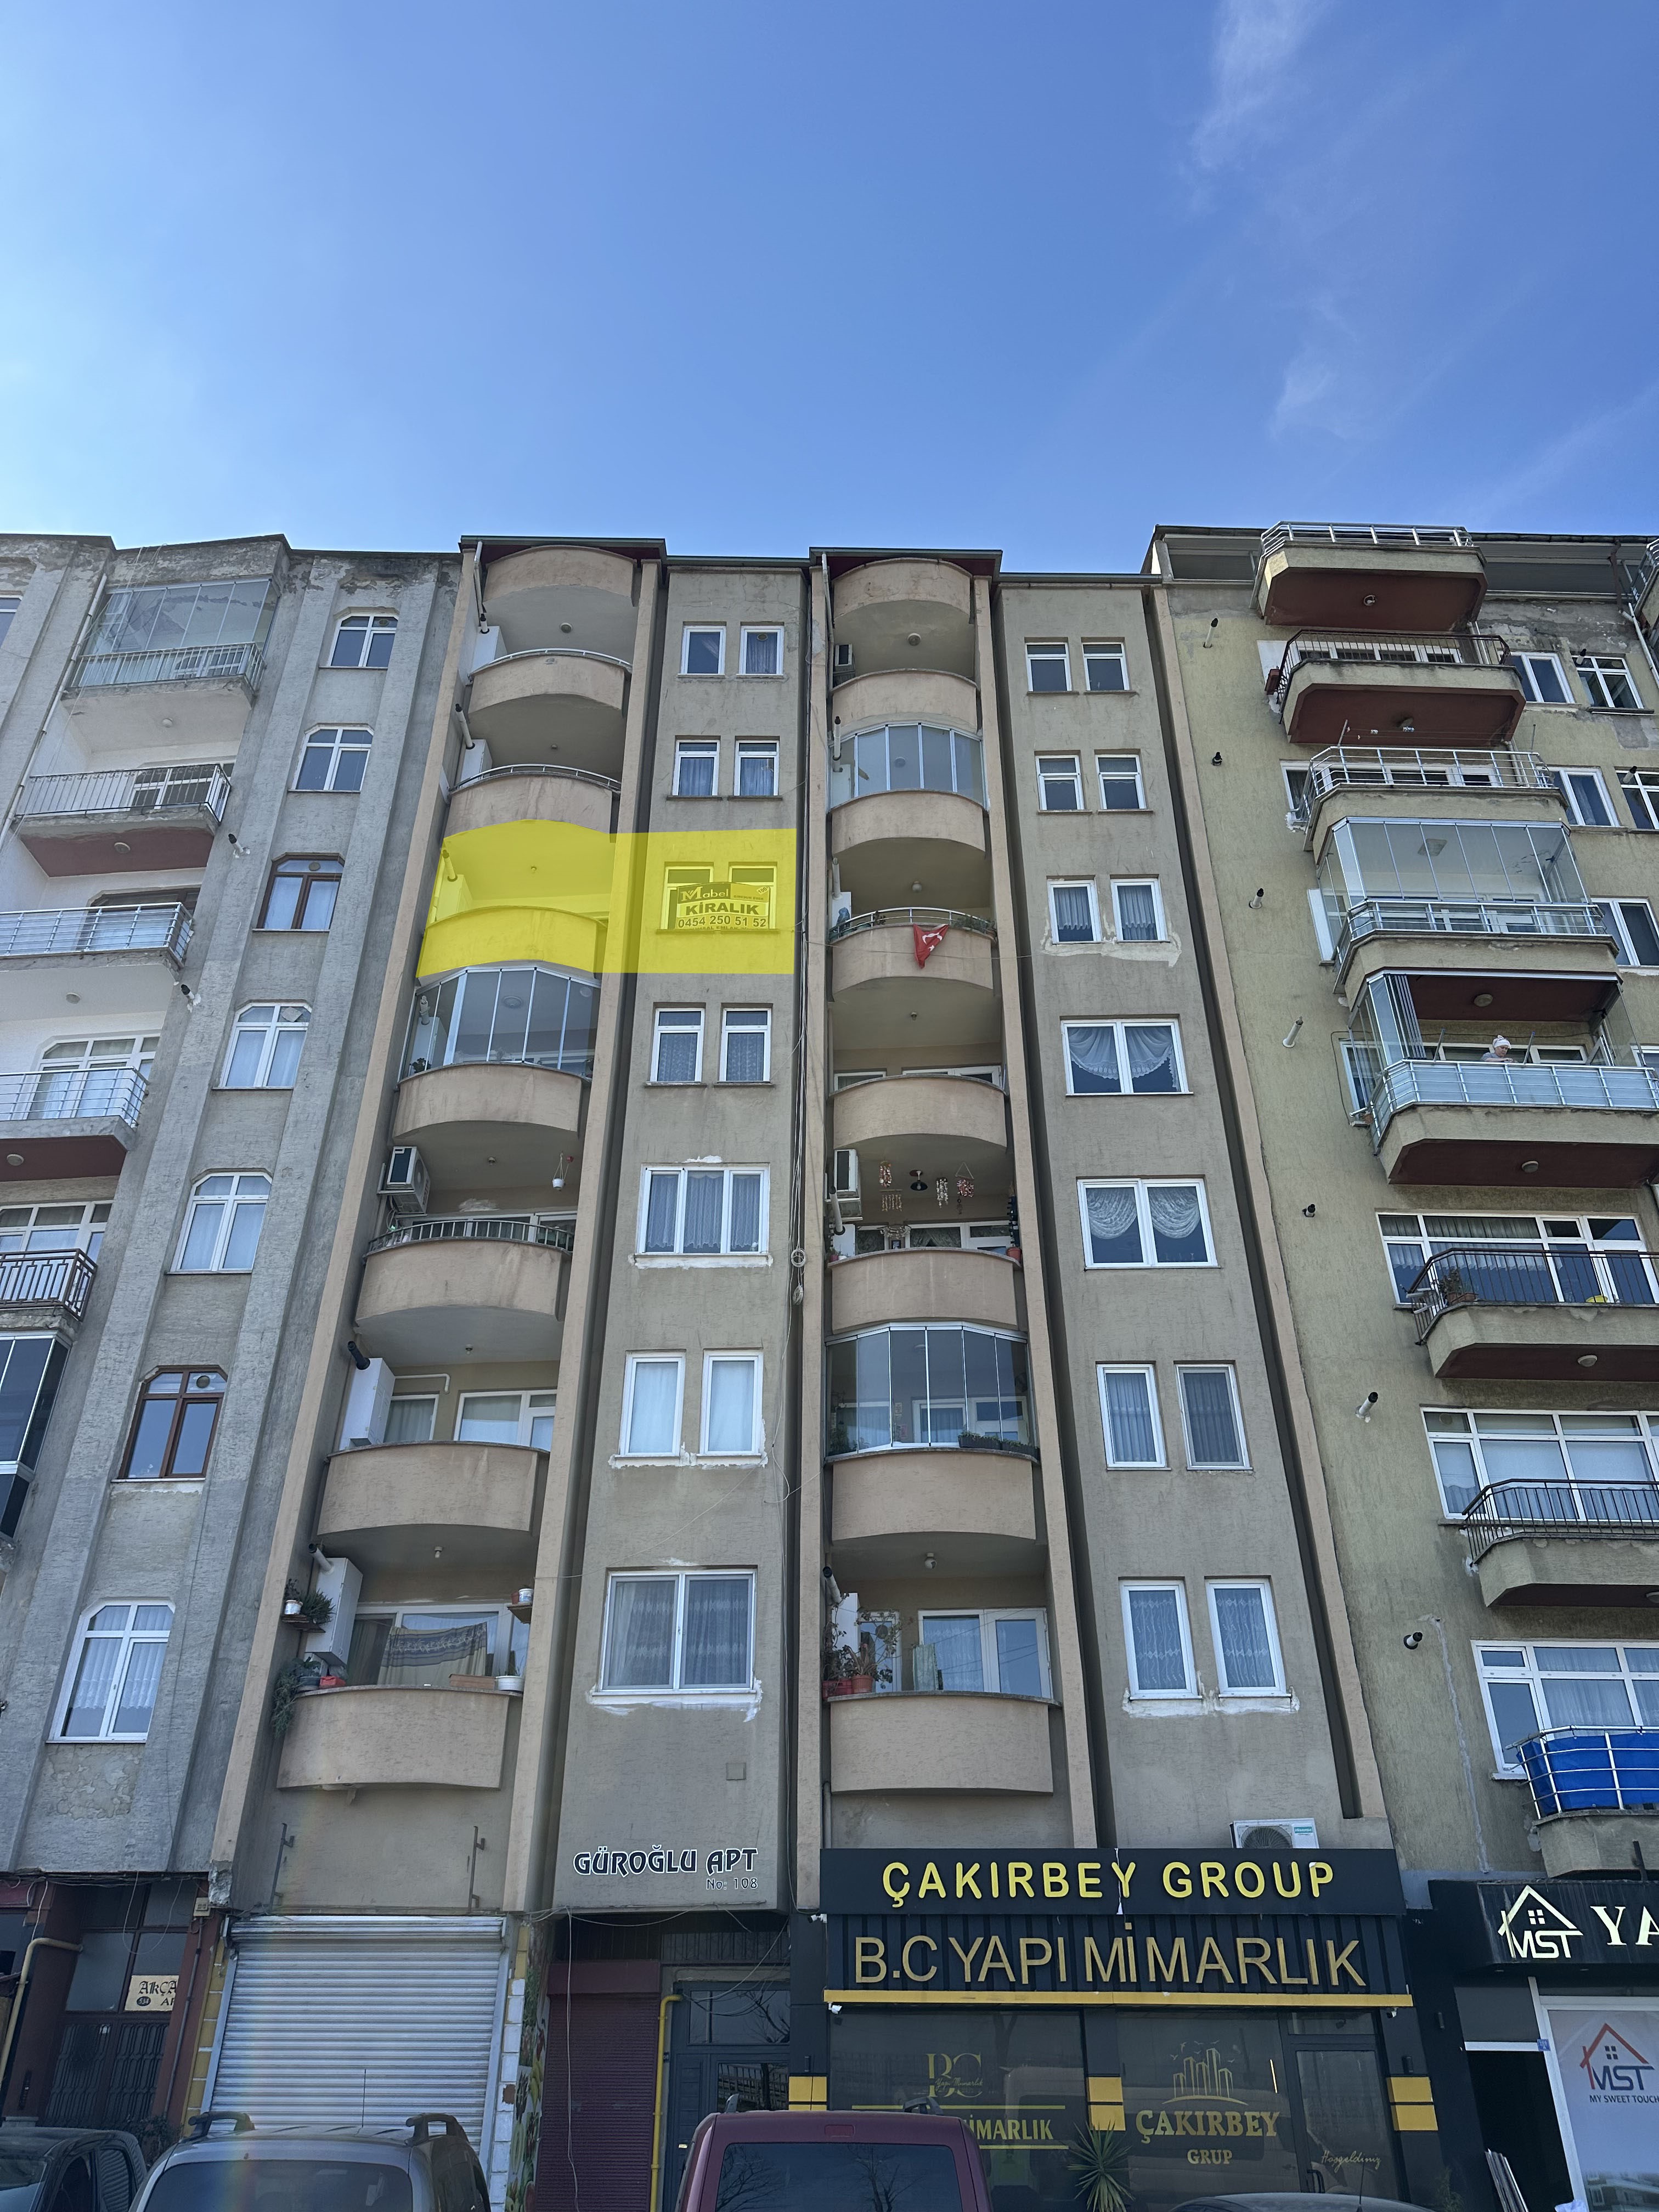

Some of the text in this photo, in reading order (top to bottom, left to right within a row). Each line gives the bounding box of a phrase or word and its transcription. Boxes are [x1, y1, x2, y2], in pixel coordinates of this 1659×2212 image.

[680, 886, 729, 901] Mabel
[678, 915, 766, 928] 0454 250 51 52
[686, 902, 760, 916] KİRALIK
[573, 1844, 758, 1877] GÜROĞLU APT
[707, 1878, 758, 1890] No: 108
[882, 1861, 1334, 1908] ÇAKIRBEY GROUP
[855, 1922, 1367, 1987] B.C YAPI MİMARLIK
[1505, 1930, 1583, 1958] MST
[926, 2051, 983, 2097] BC
[1587, 2066, 1655, 2091] MST
[964, 2114, 1054, 2140] İMARLIK
[1136, 2110, 1280, 2144] ÇAKIRBEY
[1187, 2149, 1233, 2165] GRUP
